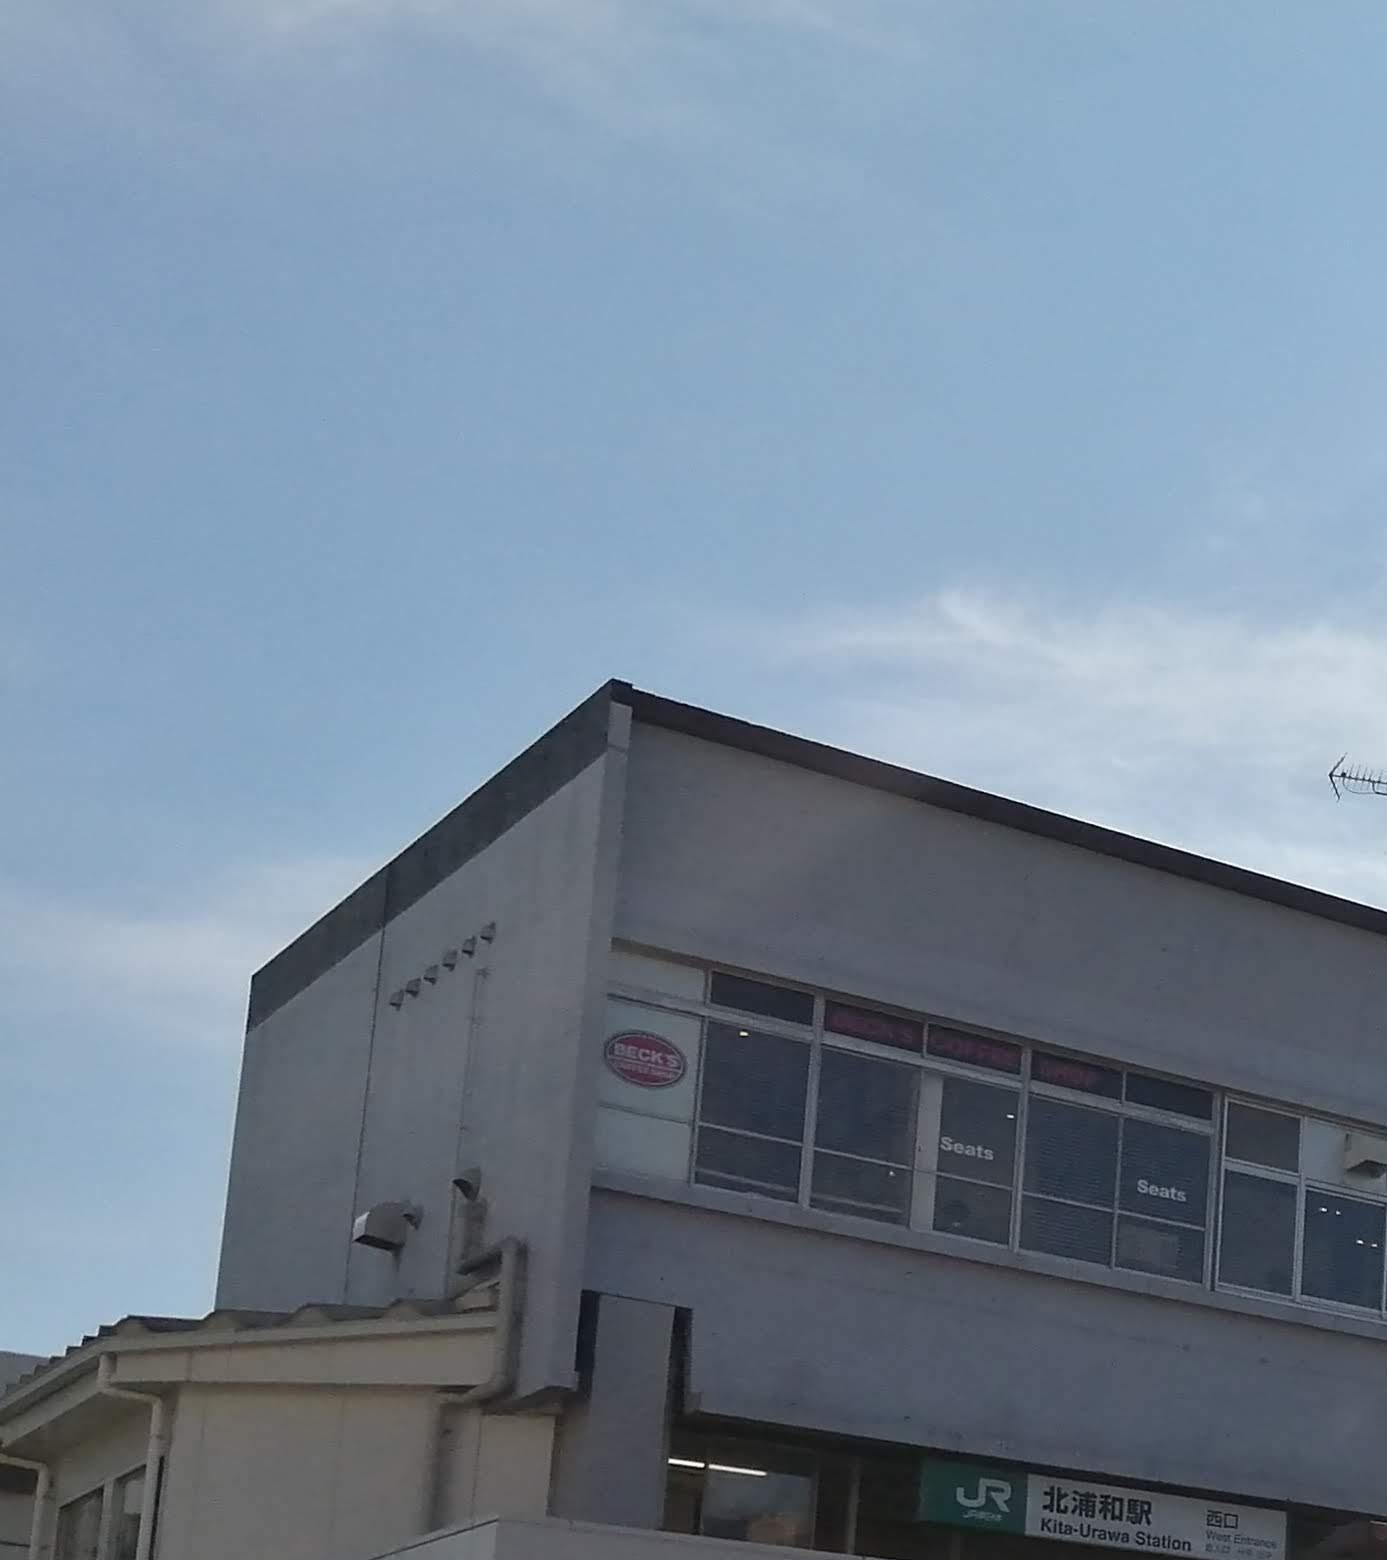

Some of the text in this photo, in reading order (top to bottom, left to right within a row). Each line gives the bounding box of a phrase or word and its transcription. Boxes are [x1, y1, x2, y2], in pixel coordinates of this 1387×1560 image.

[940, 1136, 995, 1161] Seats
[1137, 1179, 1188, 1202] Seats
[956, 1477, 1011, 1513] JR
[1042, 1486, 1153, 1526] 北浦和駅
[1206, 1509, 1240, 1530] 西口
[1040, 1517, 1130, 1544] Kita-Urawa
[1135, 1530, 1192, 1553] Station
[1206, 1530, 1232, 1544] West
